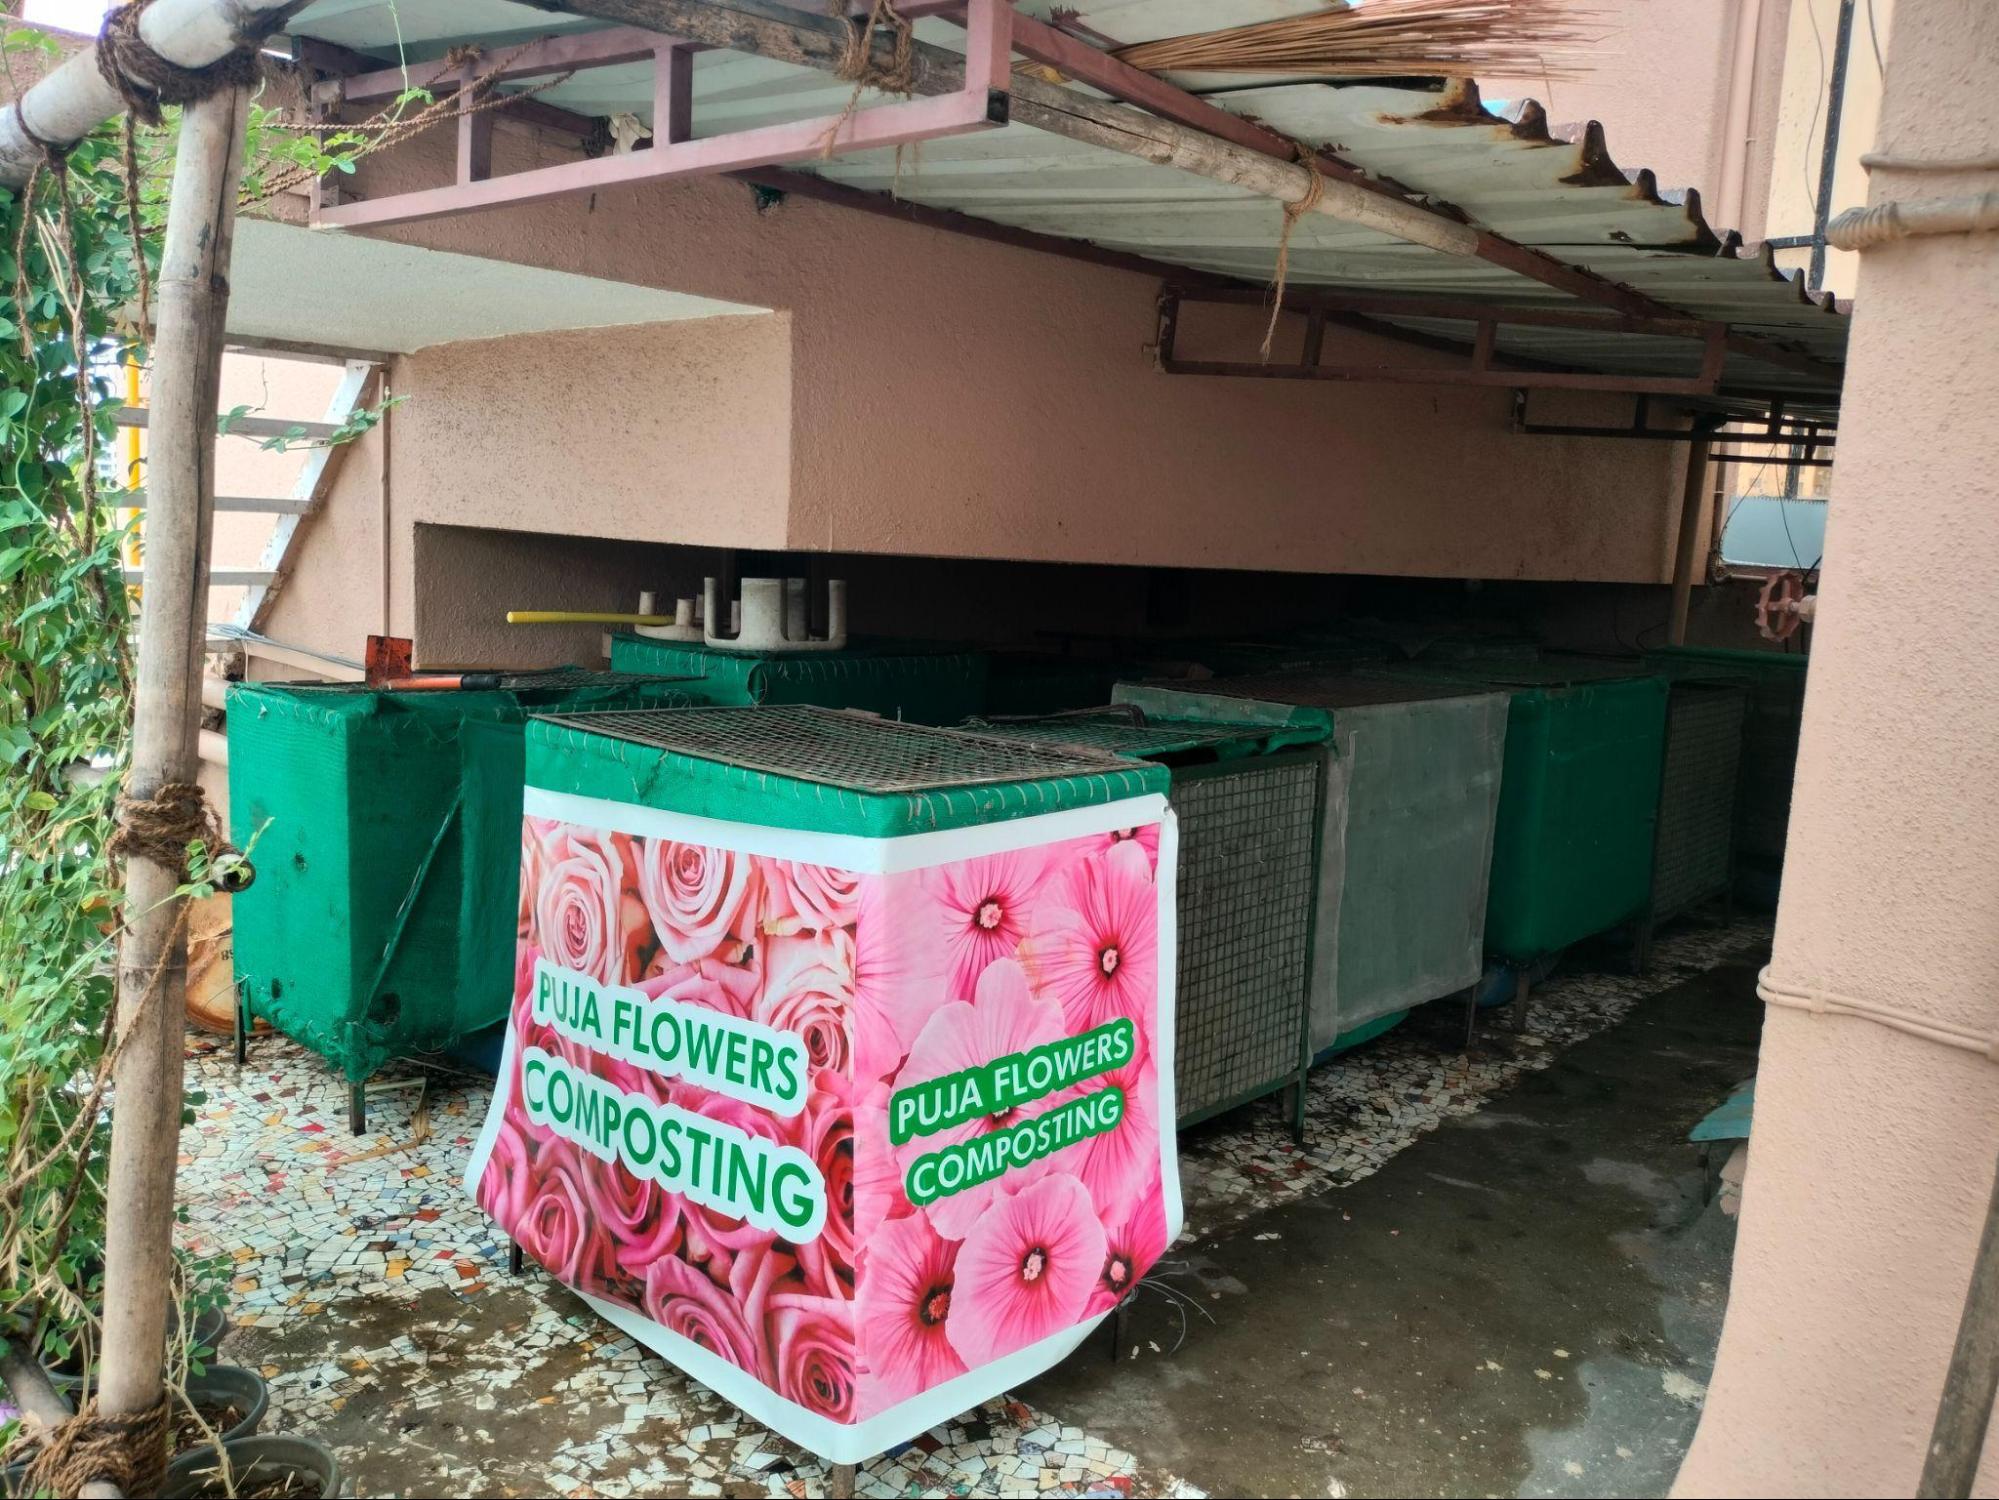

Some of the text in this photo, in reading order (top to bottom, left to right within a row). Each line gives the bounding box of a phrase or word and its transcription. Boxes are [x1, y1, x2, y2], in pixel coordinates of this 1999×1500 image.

[539, 971, 798, 1101] PUJA FLOWERS
[898, 1027, 1128, 1134] PUJA FLOWERS
[526, 1060, 814, 1227] COMPOSTING
[913, 1094, 1119, 1198] COMPOSTING
